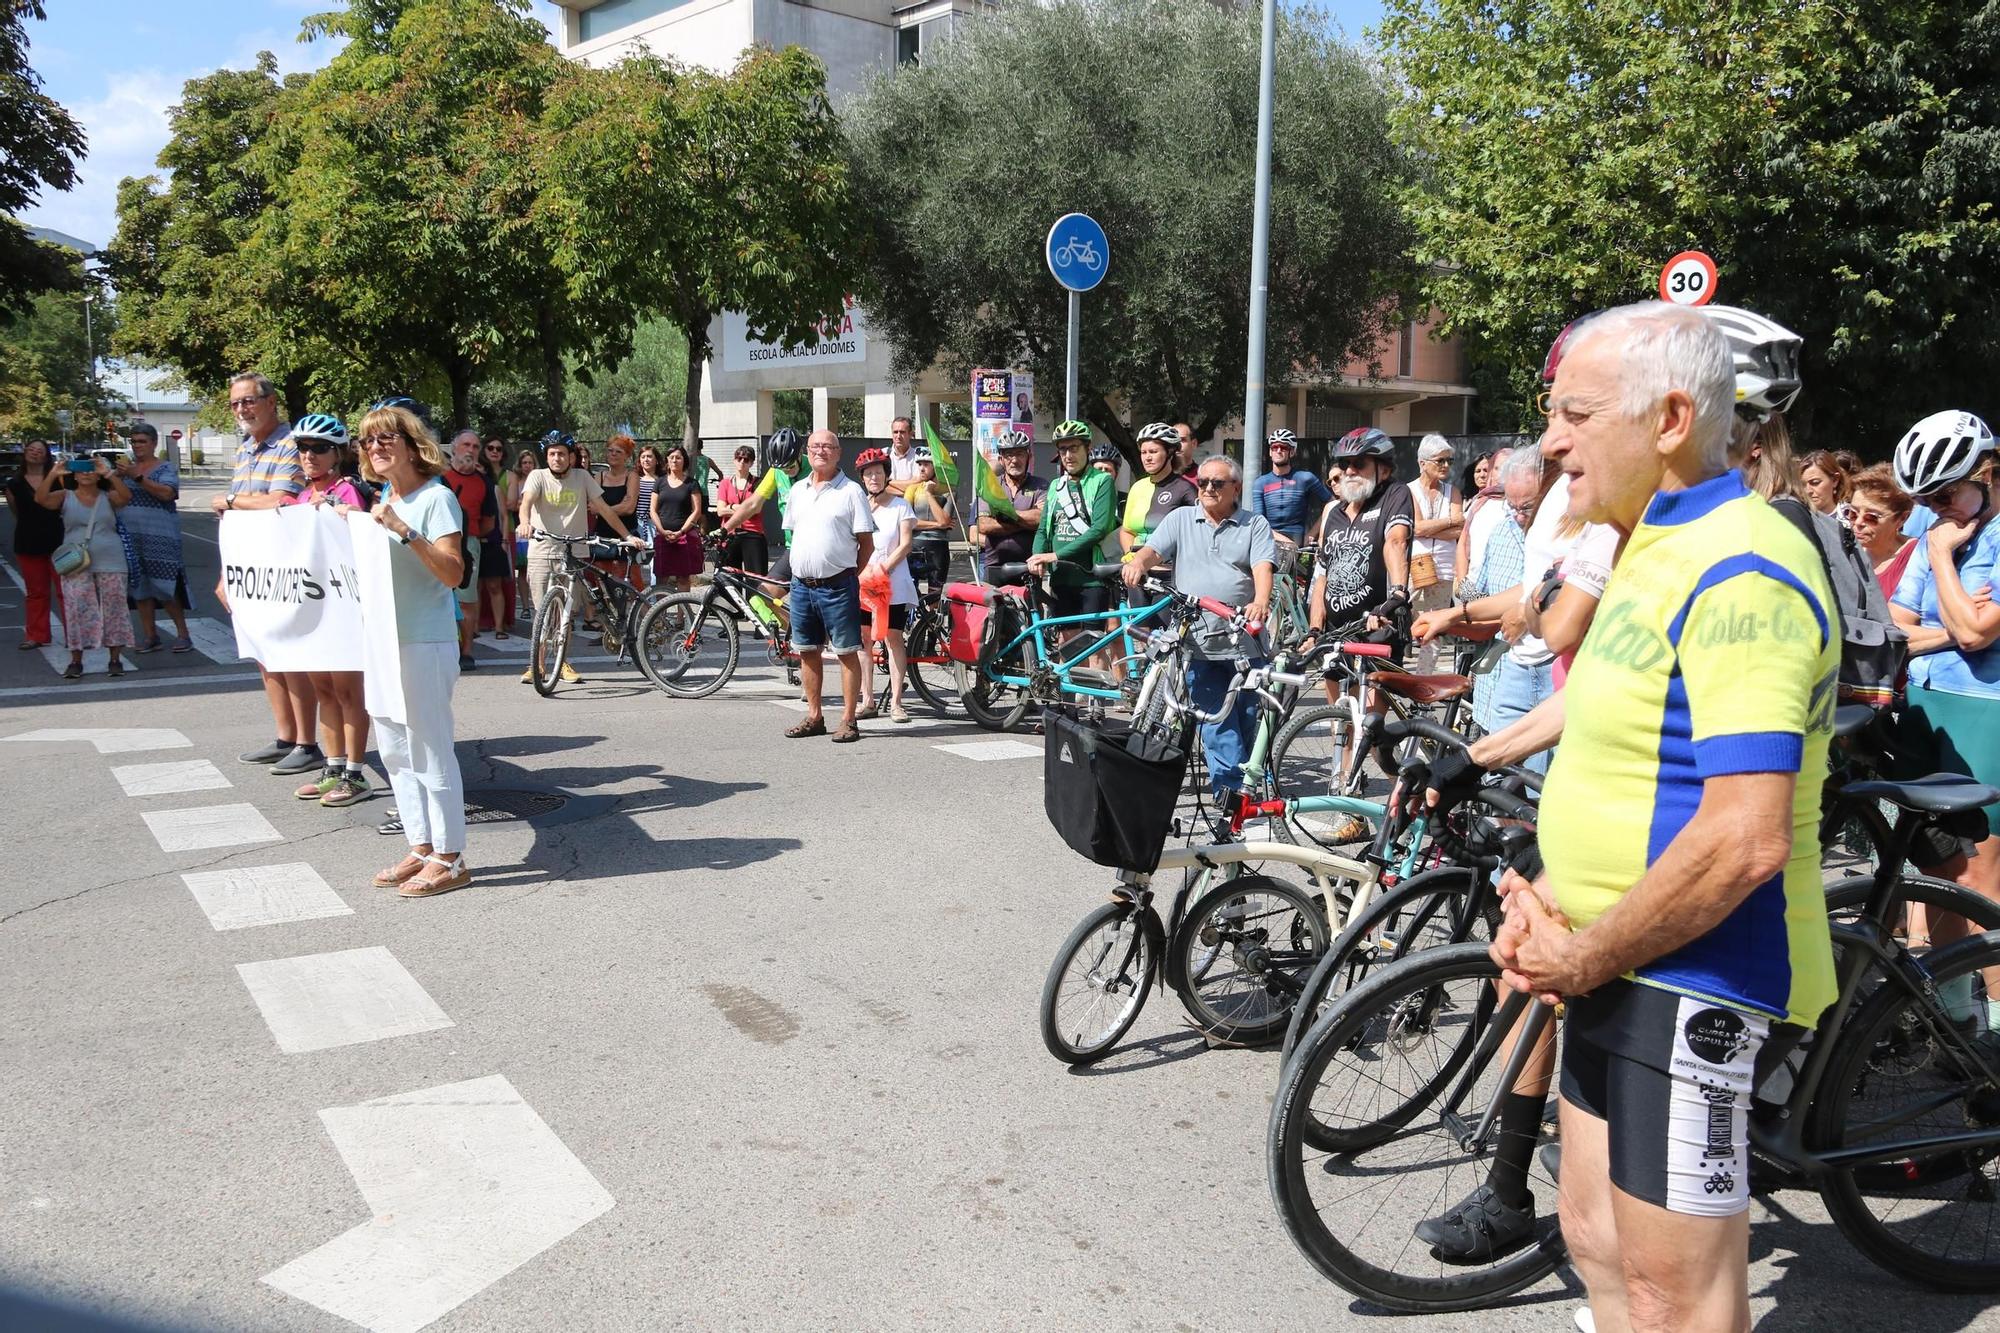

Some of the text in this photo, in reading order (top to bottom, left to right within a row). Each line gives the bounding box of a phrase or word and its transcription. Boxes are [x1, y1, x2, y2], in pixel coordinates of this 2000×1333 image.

[1671, 271, 1704, 293] 30
[749, 349, 777, 361] ESCOLA
[1324, 526, 1370, 555] CYCLING
[226, 565, 273, 600] PROUS
[270, 567, 326, 604] MORS
[1330, 584, 1373, 613] GIRONA
[1714, 1019, 1726, 1028] VI
[1673, 1058, 1697, 1069] SANTA
